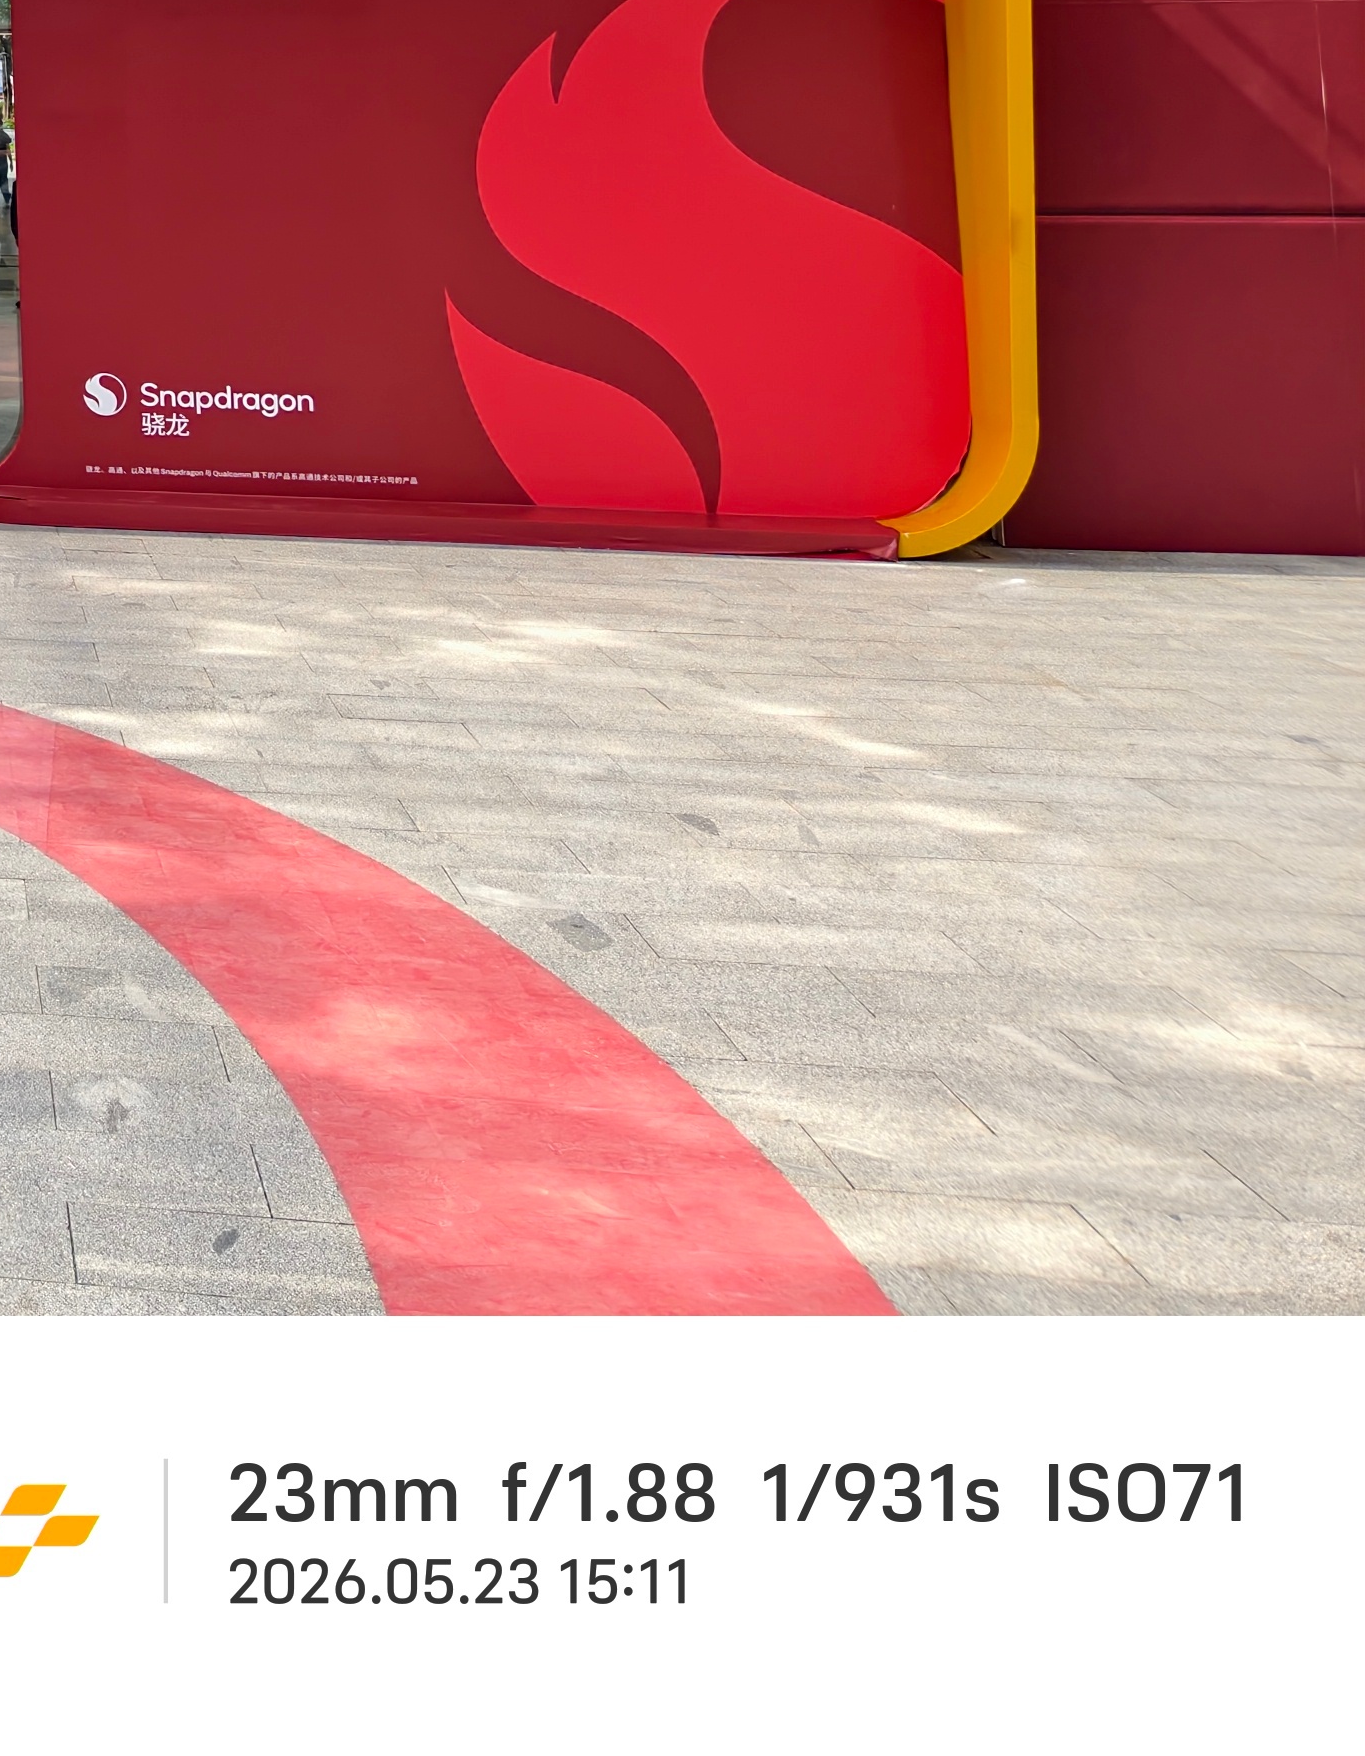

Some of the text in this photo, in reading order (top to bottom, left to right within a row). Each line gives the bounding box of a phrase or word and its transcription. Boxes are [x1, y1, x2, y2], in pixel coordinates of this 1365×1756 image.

[140, 382, 315, 418] Snapdragon
[141, 412, 190, 437] 骁龙
[160, 468, 204, 477] Snapdragon
[212, 470, 252, 479] Qualcomm
